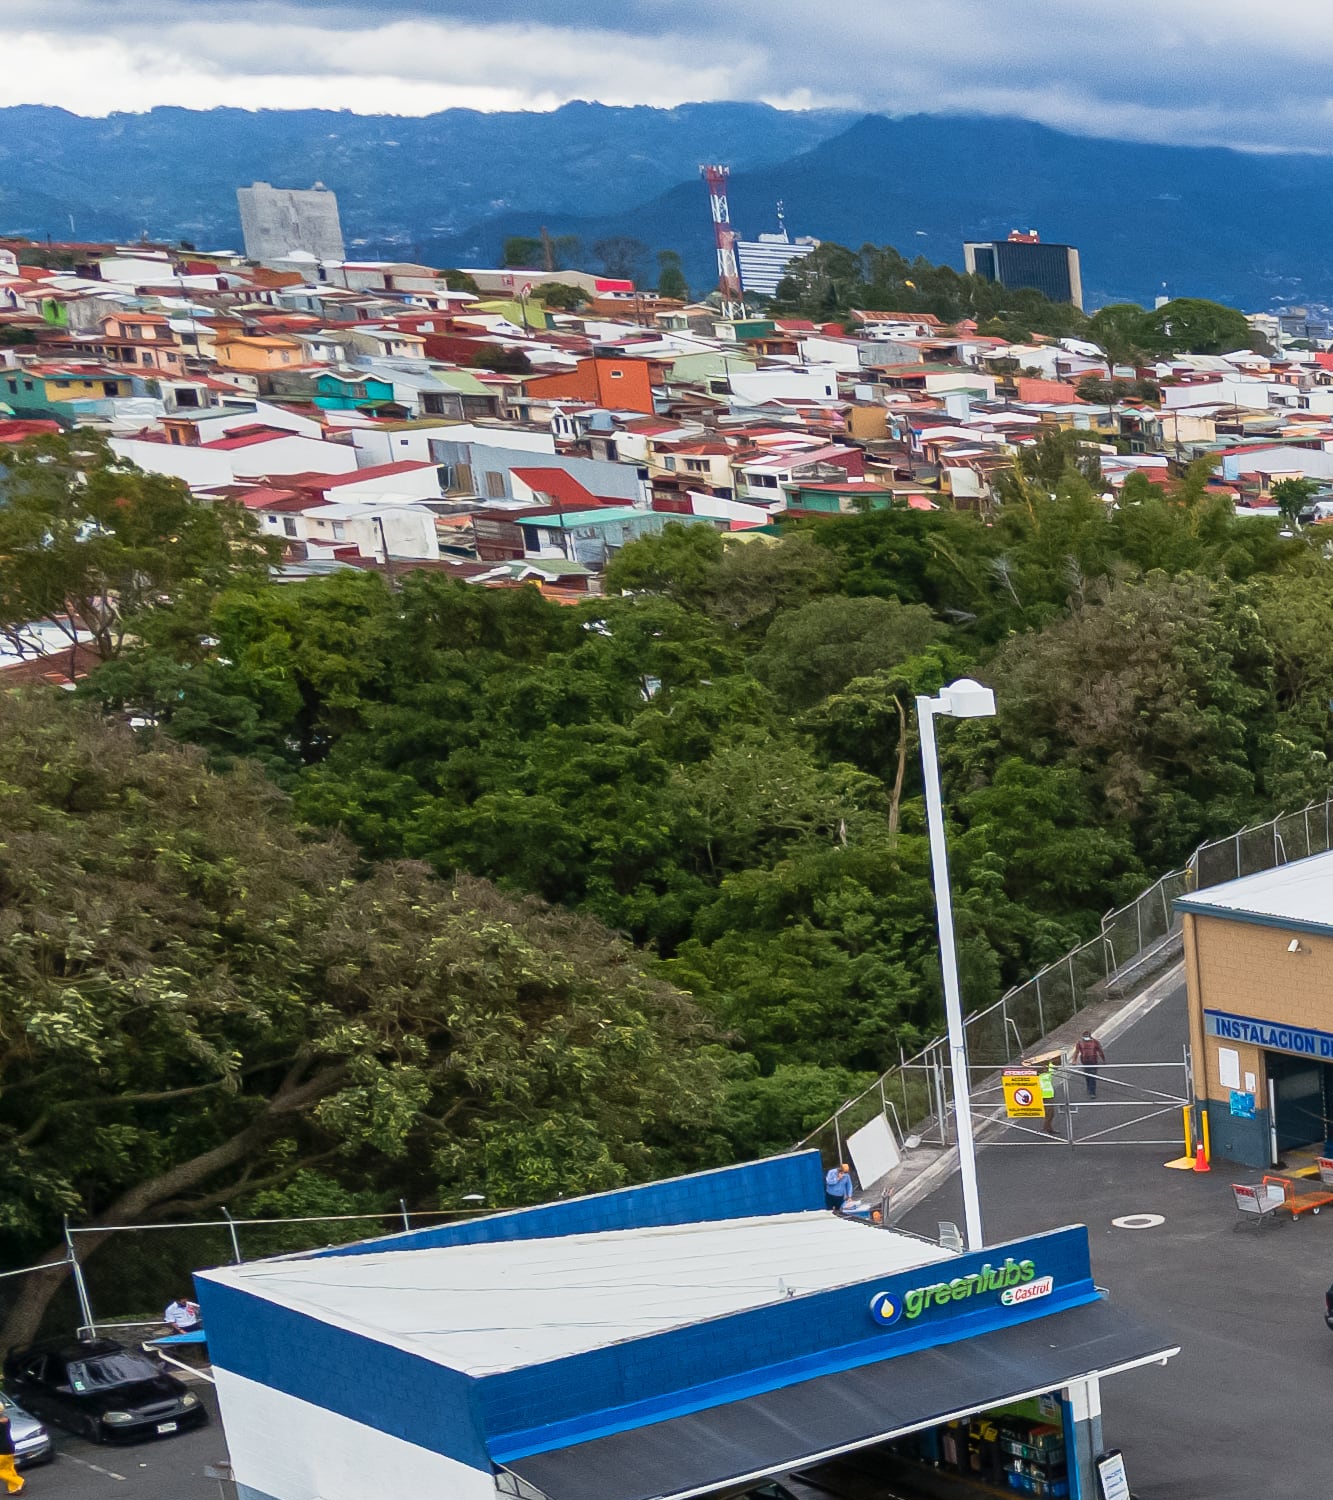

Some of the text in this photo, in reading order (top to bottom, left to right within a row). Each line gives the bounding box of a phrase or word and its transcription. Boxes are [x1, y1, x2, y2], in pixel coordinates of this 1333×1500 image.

[1215, 1017, 1316, 1053] INSTALACION
[905, 1257, 1035, 1319] greenlubs
[1014, 1281, 1050, 1301] Castrol
